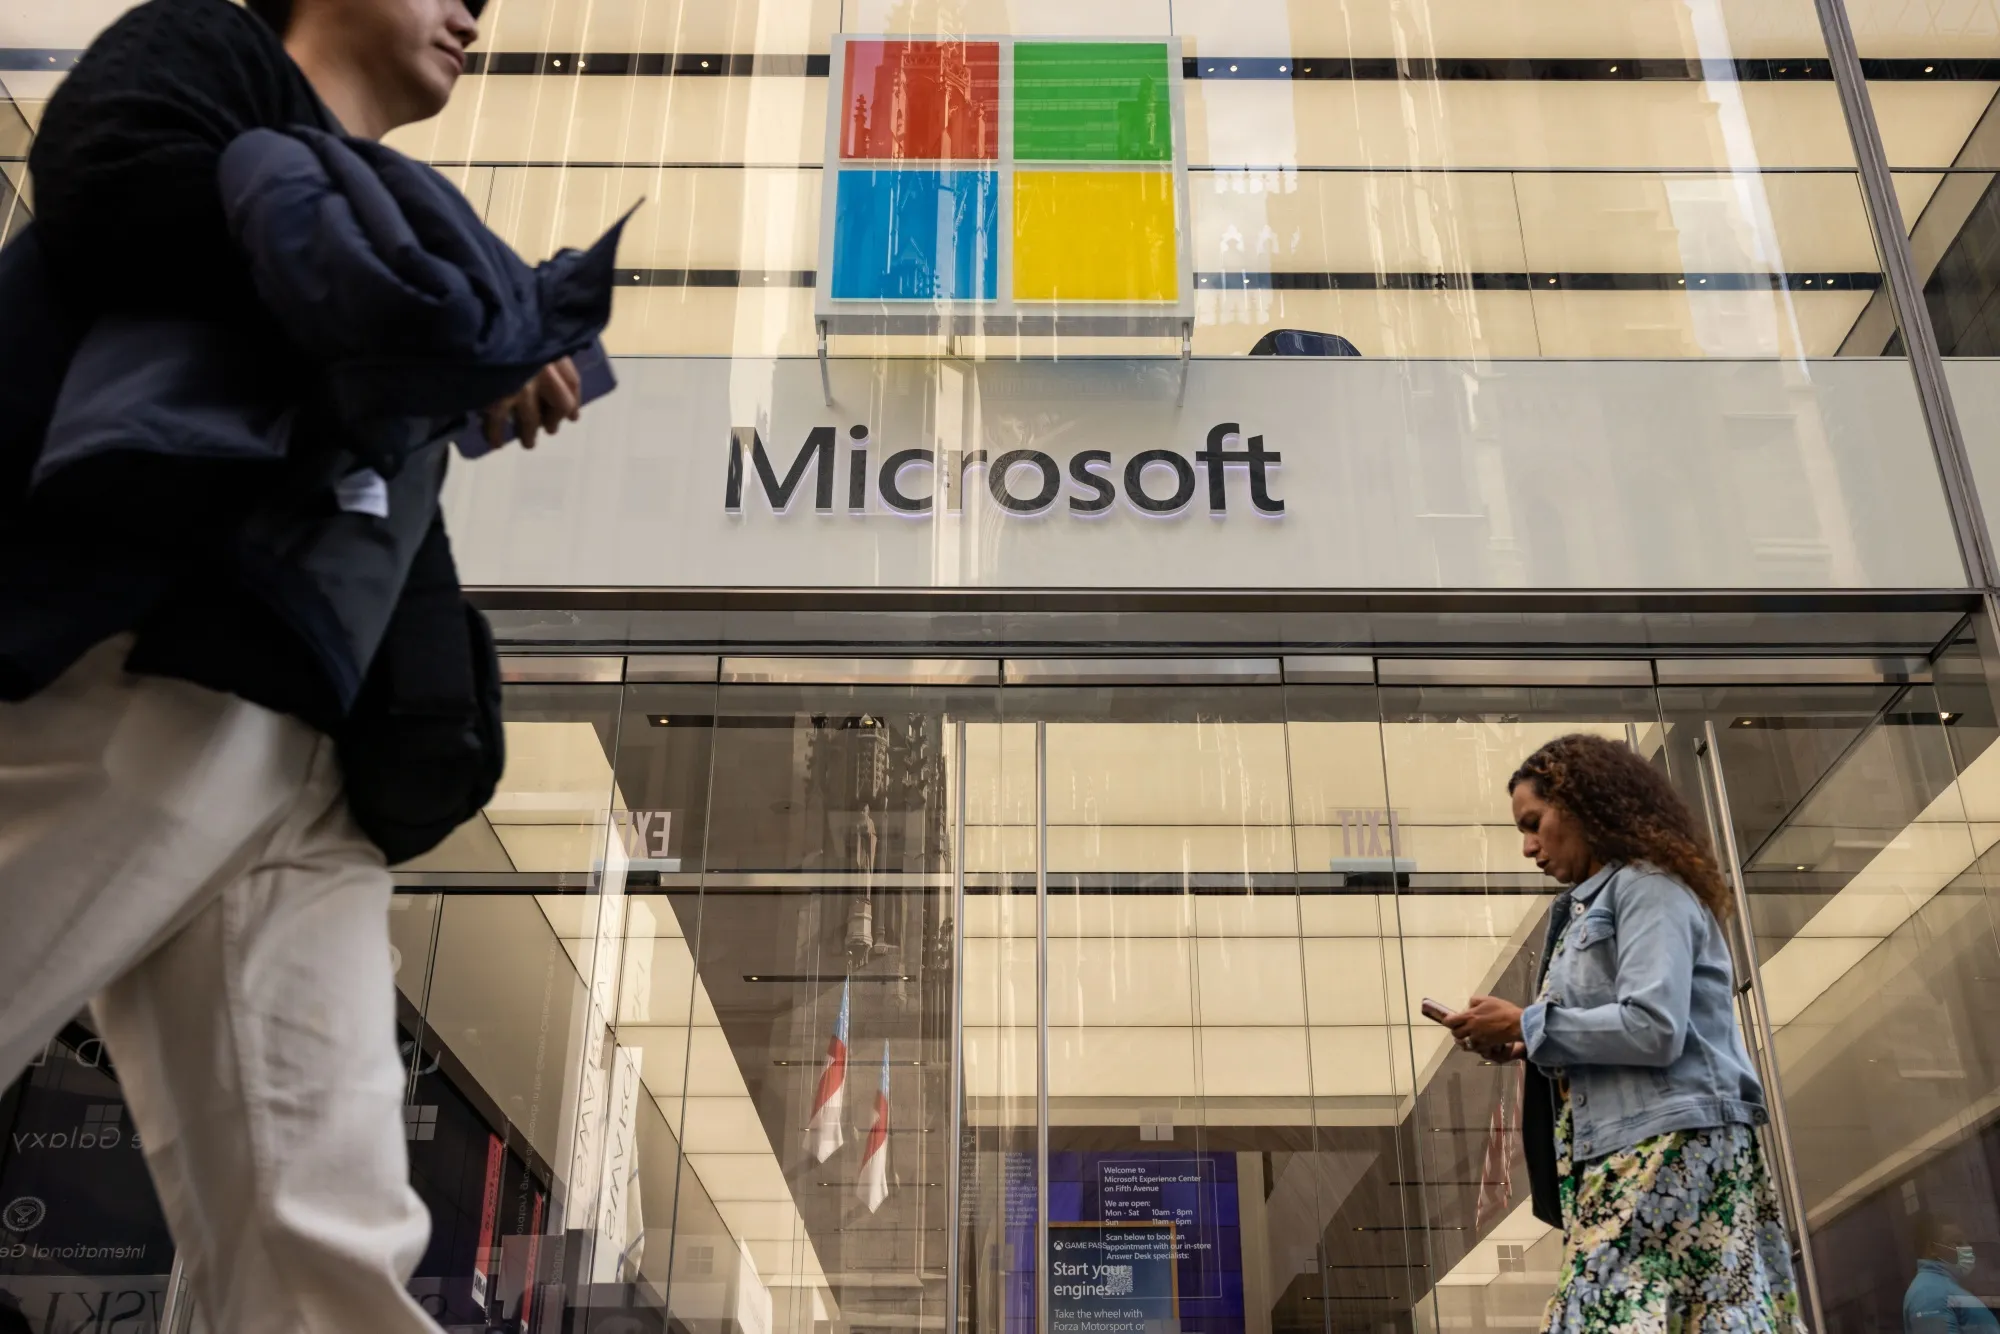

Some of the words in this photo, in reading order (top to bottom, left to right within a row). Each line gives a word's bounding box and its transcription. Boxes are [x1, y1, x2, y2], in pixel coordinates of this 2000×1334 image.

[725, 422, 1285, 514] Microsoft
[1104, 1166, 1136, 1174] Welcome
[1139, 1175, 1177, 1184] Experience
[1130, 1201, 1151, 1209] open:
[1105, 1209, 1122, 1217] Mon
[1176, 1209, 1193, 1218] 8pm
[1105, 1218, 1119, 1226] Sun
[1175, 1218, 1192, 1227] 6pm
[1105, 1233, 1123, 1241] Scan
[1123, 1233, 1146, 1241] below
[1065, 1242, 1087, 1250] GAME
[1088, 1241, 1108, 1250] PASS
[1106, 1243, 1152, 1252] appointment
[1153, 1242, 1169, 1250] with
[1184, 1242, 1212, 1250] in-store
[1134, 1252, 1152, 1260] Desk
[1152, 1252, 1190, 1262] specialists:
[1053, 1261, 1089, 1276] Start
[1091, 1264, 1127, 1280] your
[1053, 1309, 1075, 1319] Take
[1077, 1309, 1092, 1319] the
[1093, 1308, 1121, 1319] wheel
[1123, 1308, 1143, 1319] with
[1053, 1321, 1079, 1331] Forza
[1081, 1321, 1133, 1333] Motorsport
[1135, 1323, 1145, 1331] or
